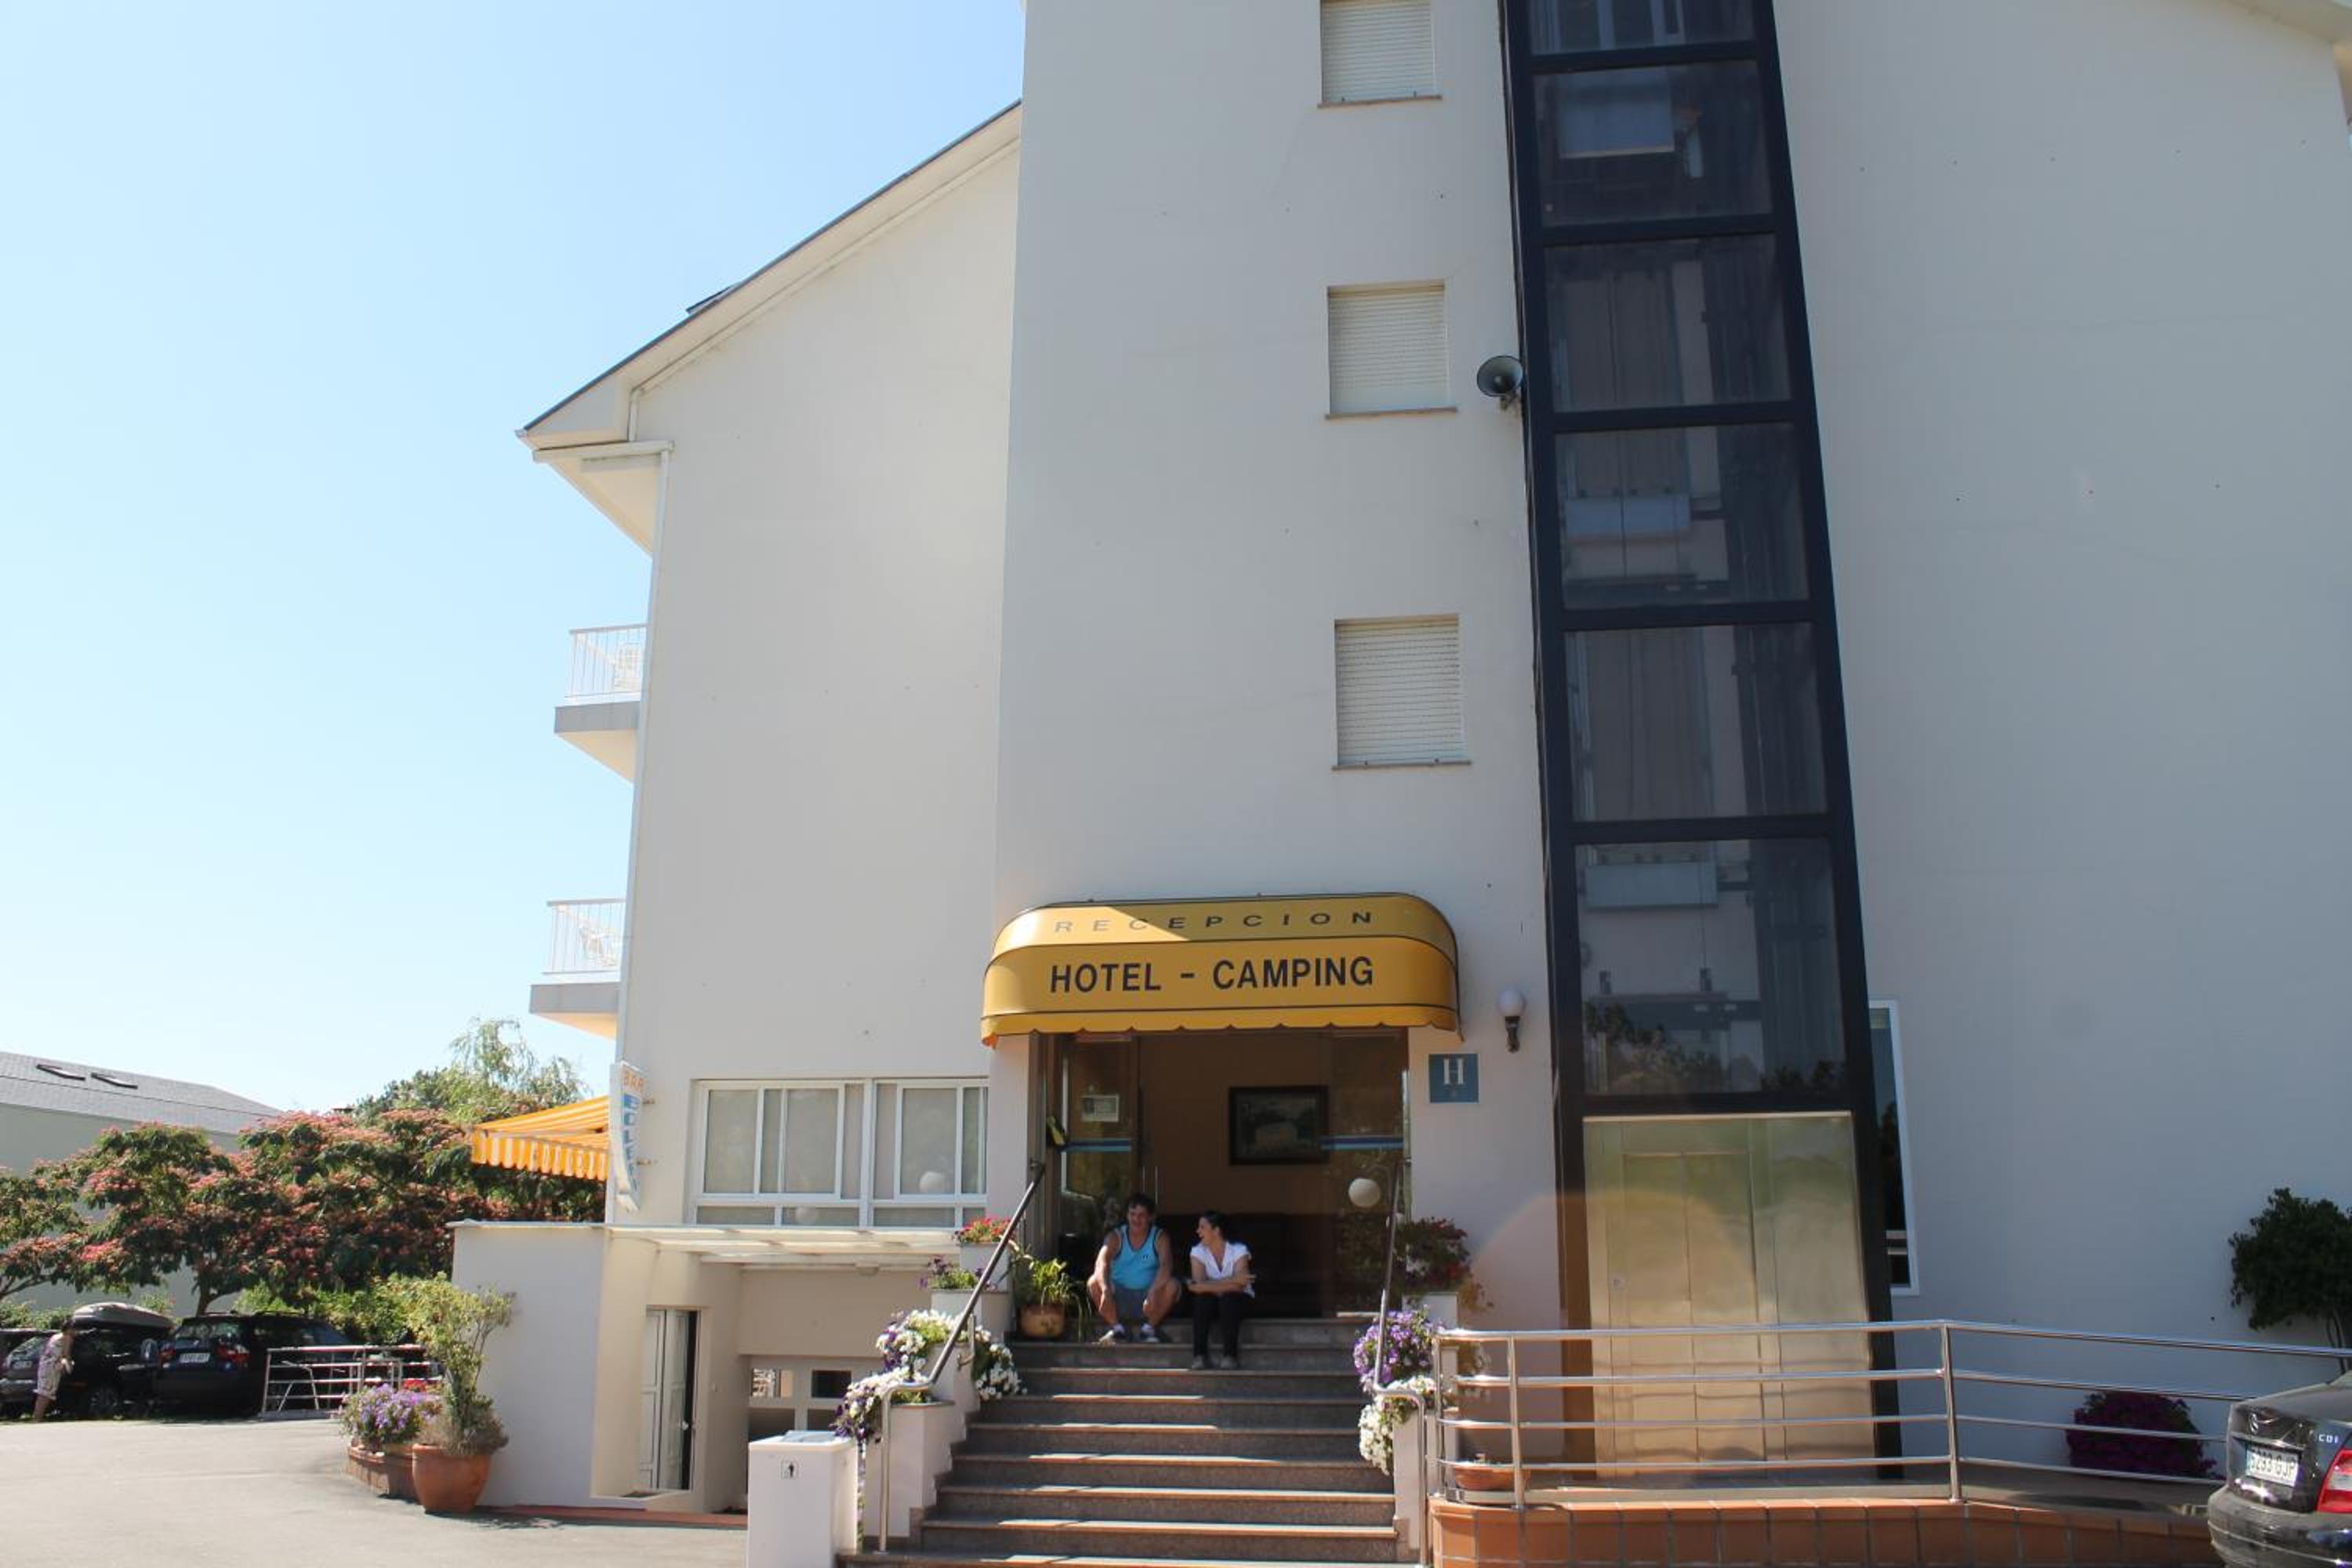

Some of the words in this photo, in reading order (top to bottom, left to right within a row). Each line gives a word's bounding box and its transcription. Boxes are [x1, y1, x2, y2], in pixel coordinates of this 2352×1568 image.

[1054, 910, 1373, 933] RECEPCION
[1050, 963, 1161, 993] HOTEL
[1212, 956, 1374, 989] CAMPING
[1443, 1058, 1464, 1084] H
